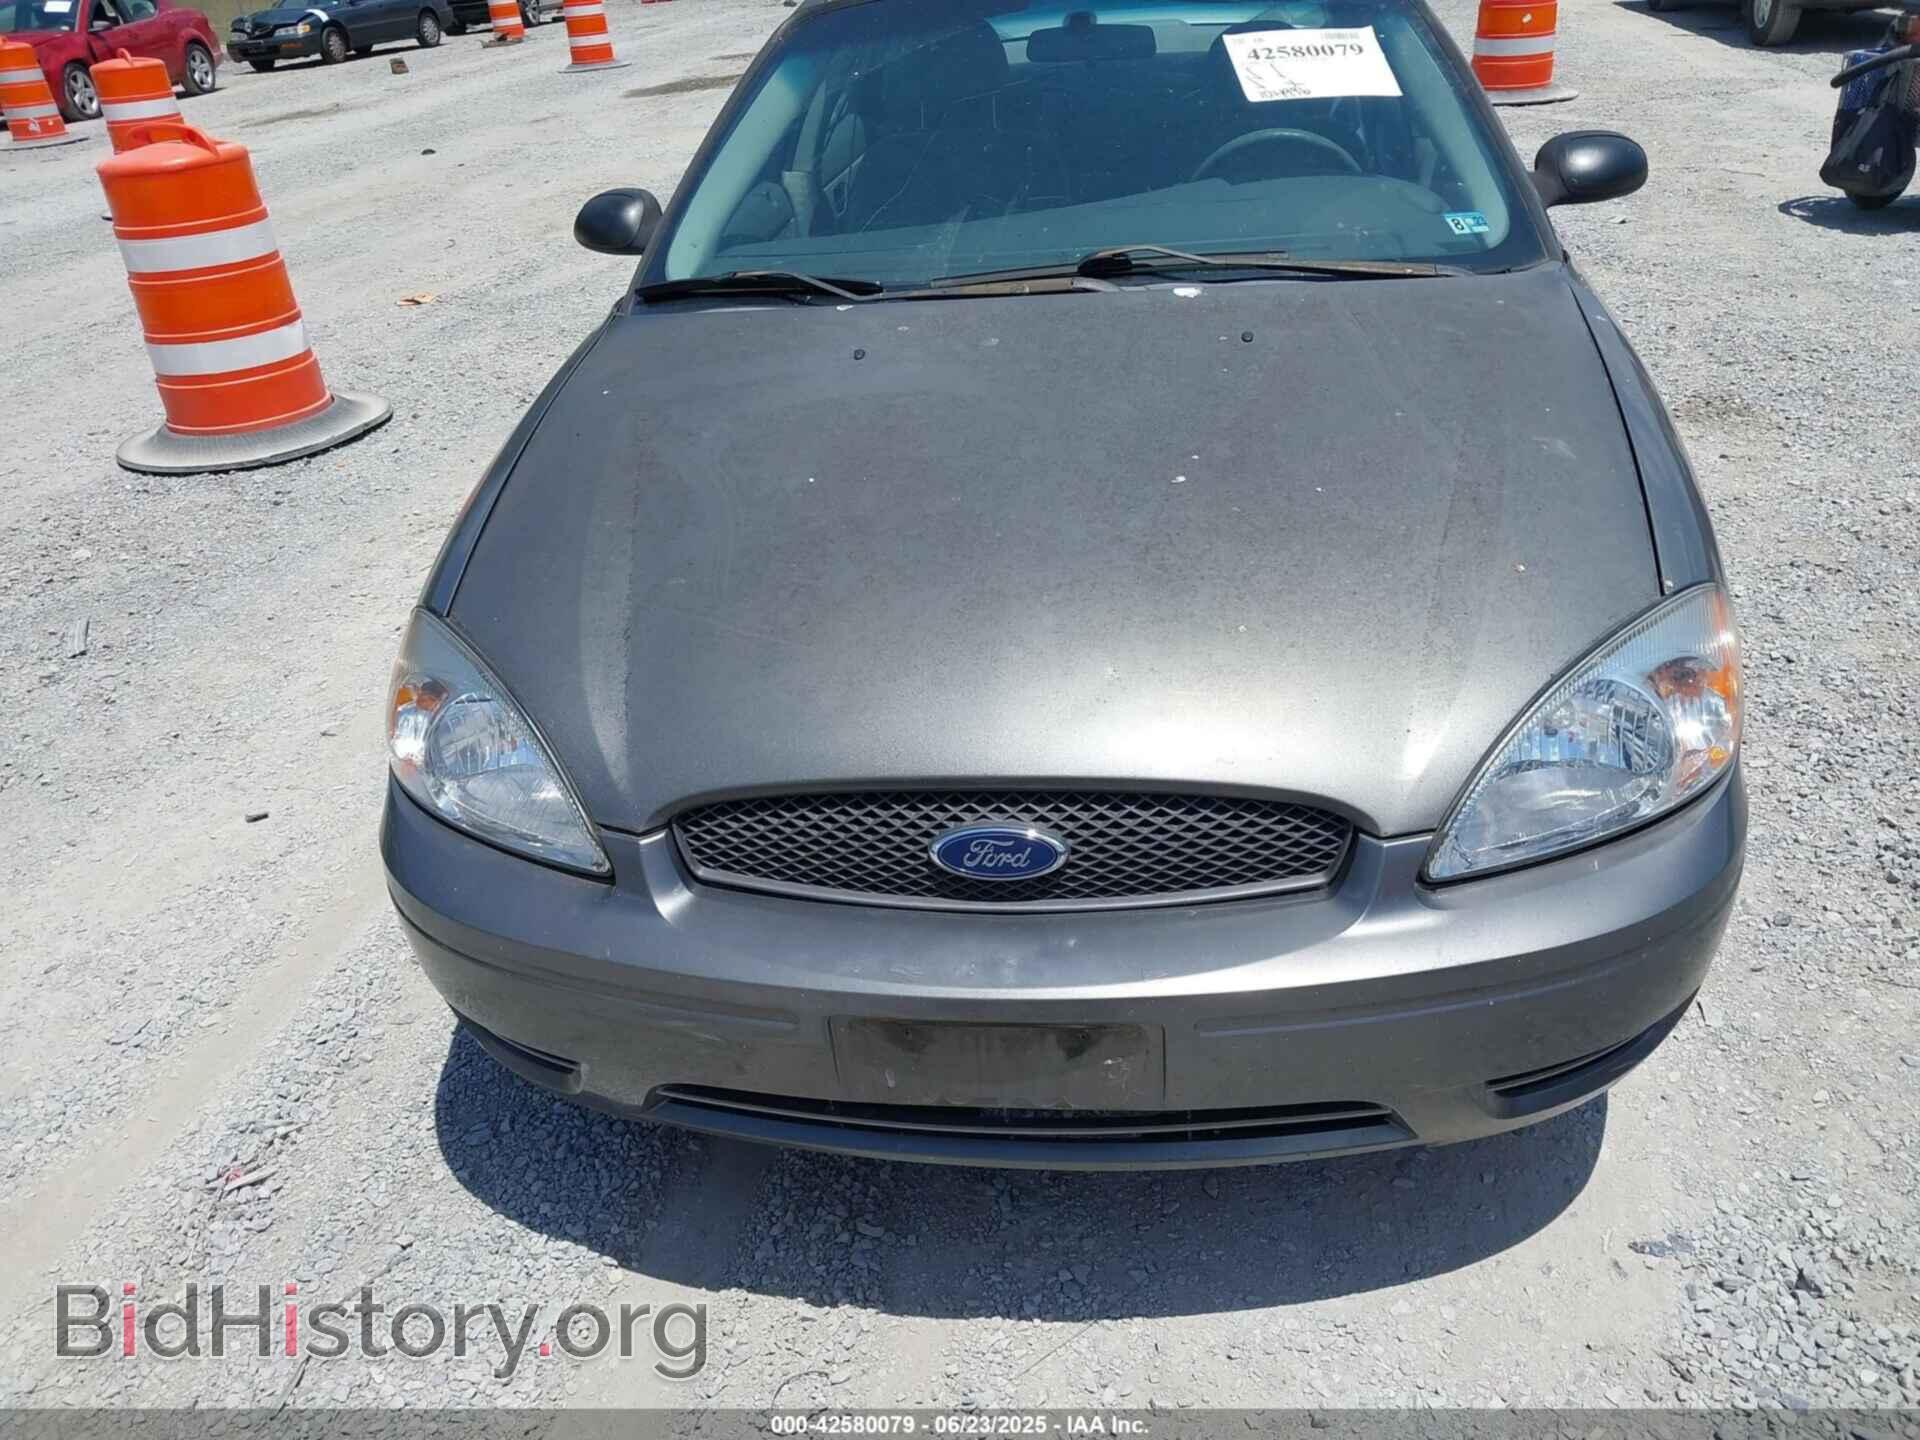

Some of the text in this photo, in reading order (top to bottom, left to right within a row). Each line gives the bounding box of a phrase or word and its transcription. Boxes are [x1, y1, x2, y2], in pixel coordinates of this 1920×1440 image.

[1247, 43, 1364, 60] 42580079
[1451, 218, 1465, 231] 8
[963, 839, 1032, 868] Ford
